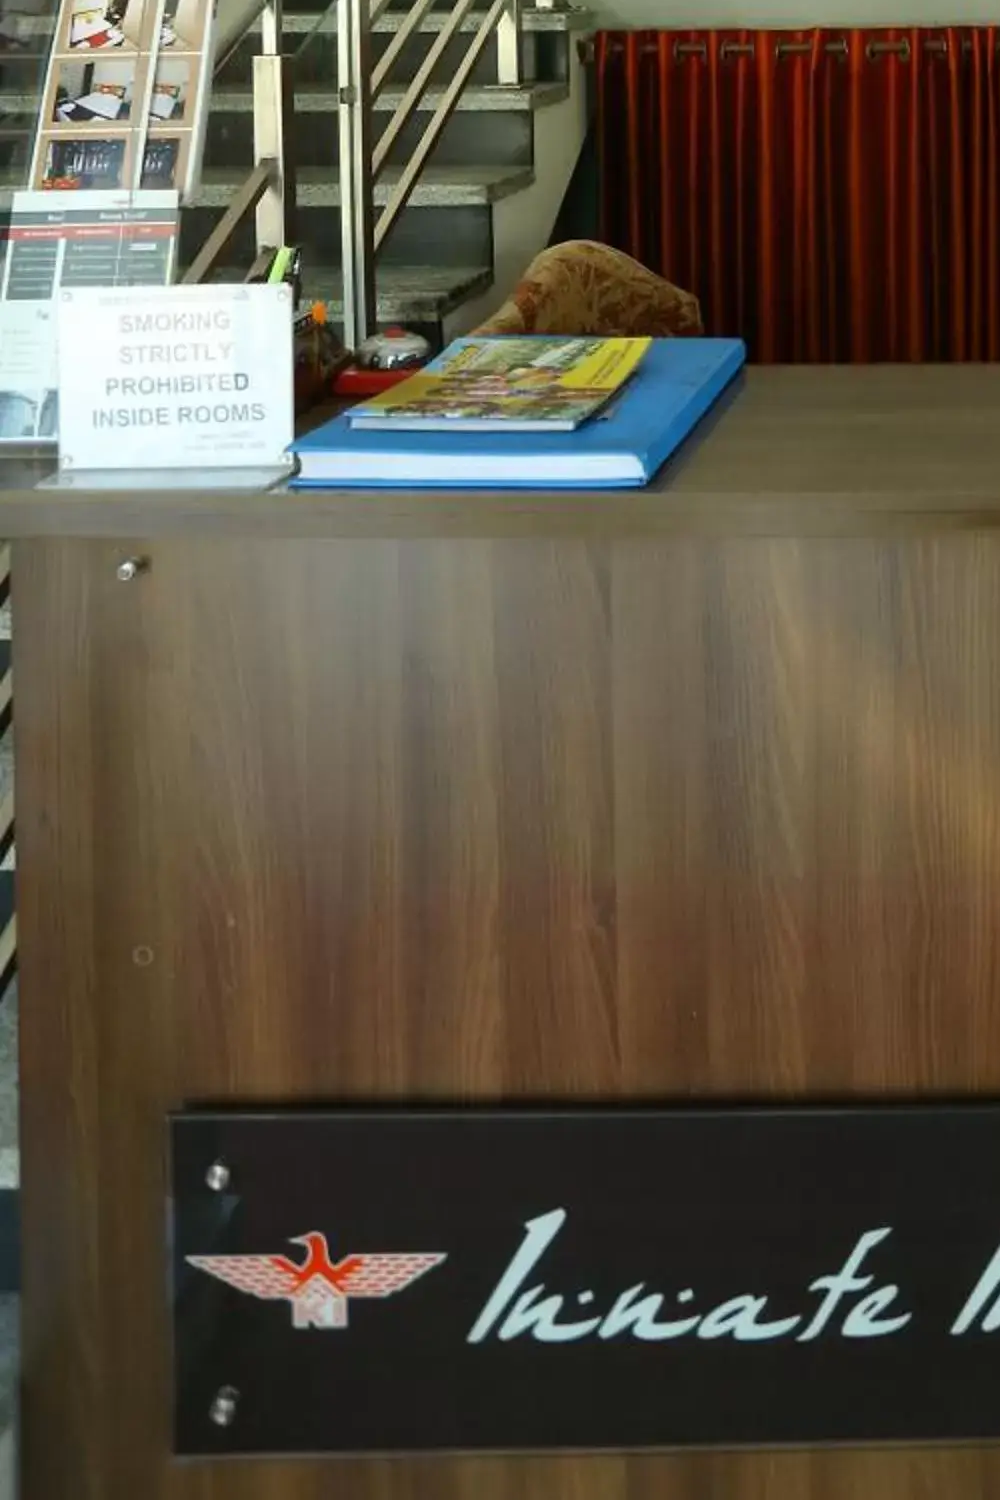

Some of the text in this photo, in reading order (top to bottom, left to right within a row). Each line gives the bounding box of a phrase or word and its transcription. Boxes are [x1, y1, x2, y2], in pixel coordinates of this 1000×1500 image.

[118, 310, 231, 333] SMOKING
[118, 342, 235, 365] STRICTLY
[105, 372, 250, 397] PROHIBITED
[92, 402, 266, 429] INSIDE ROOMS
[467, 1208, 911, 1343] Innate
